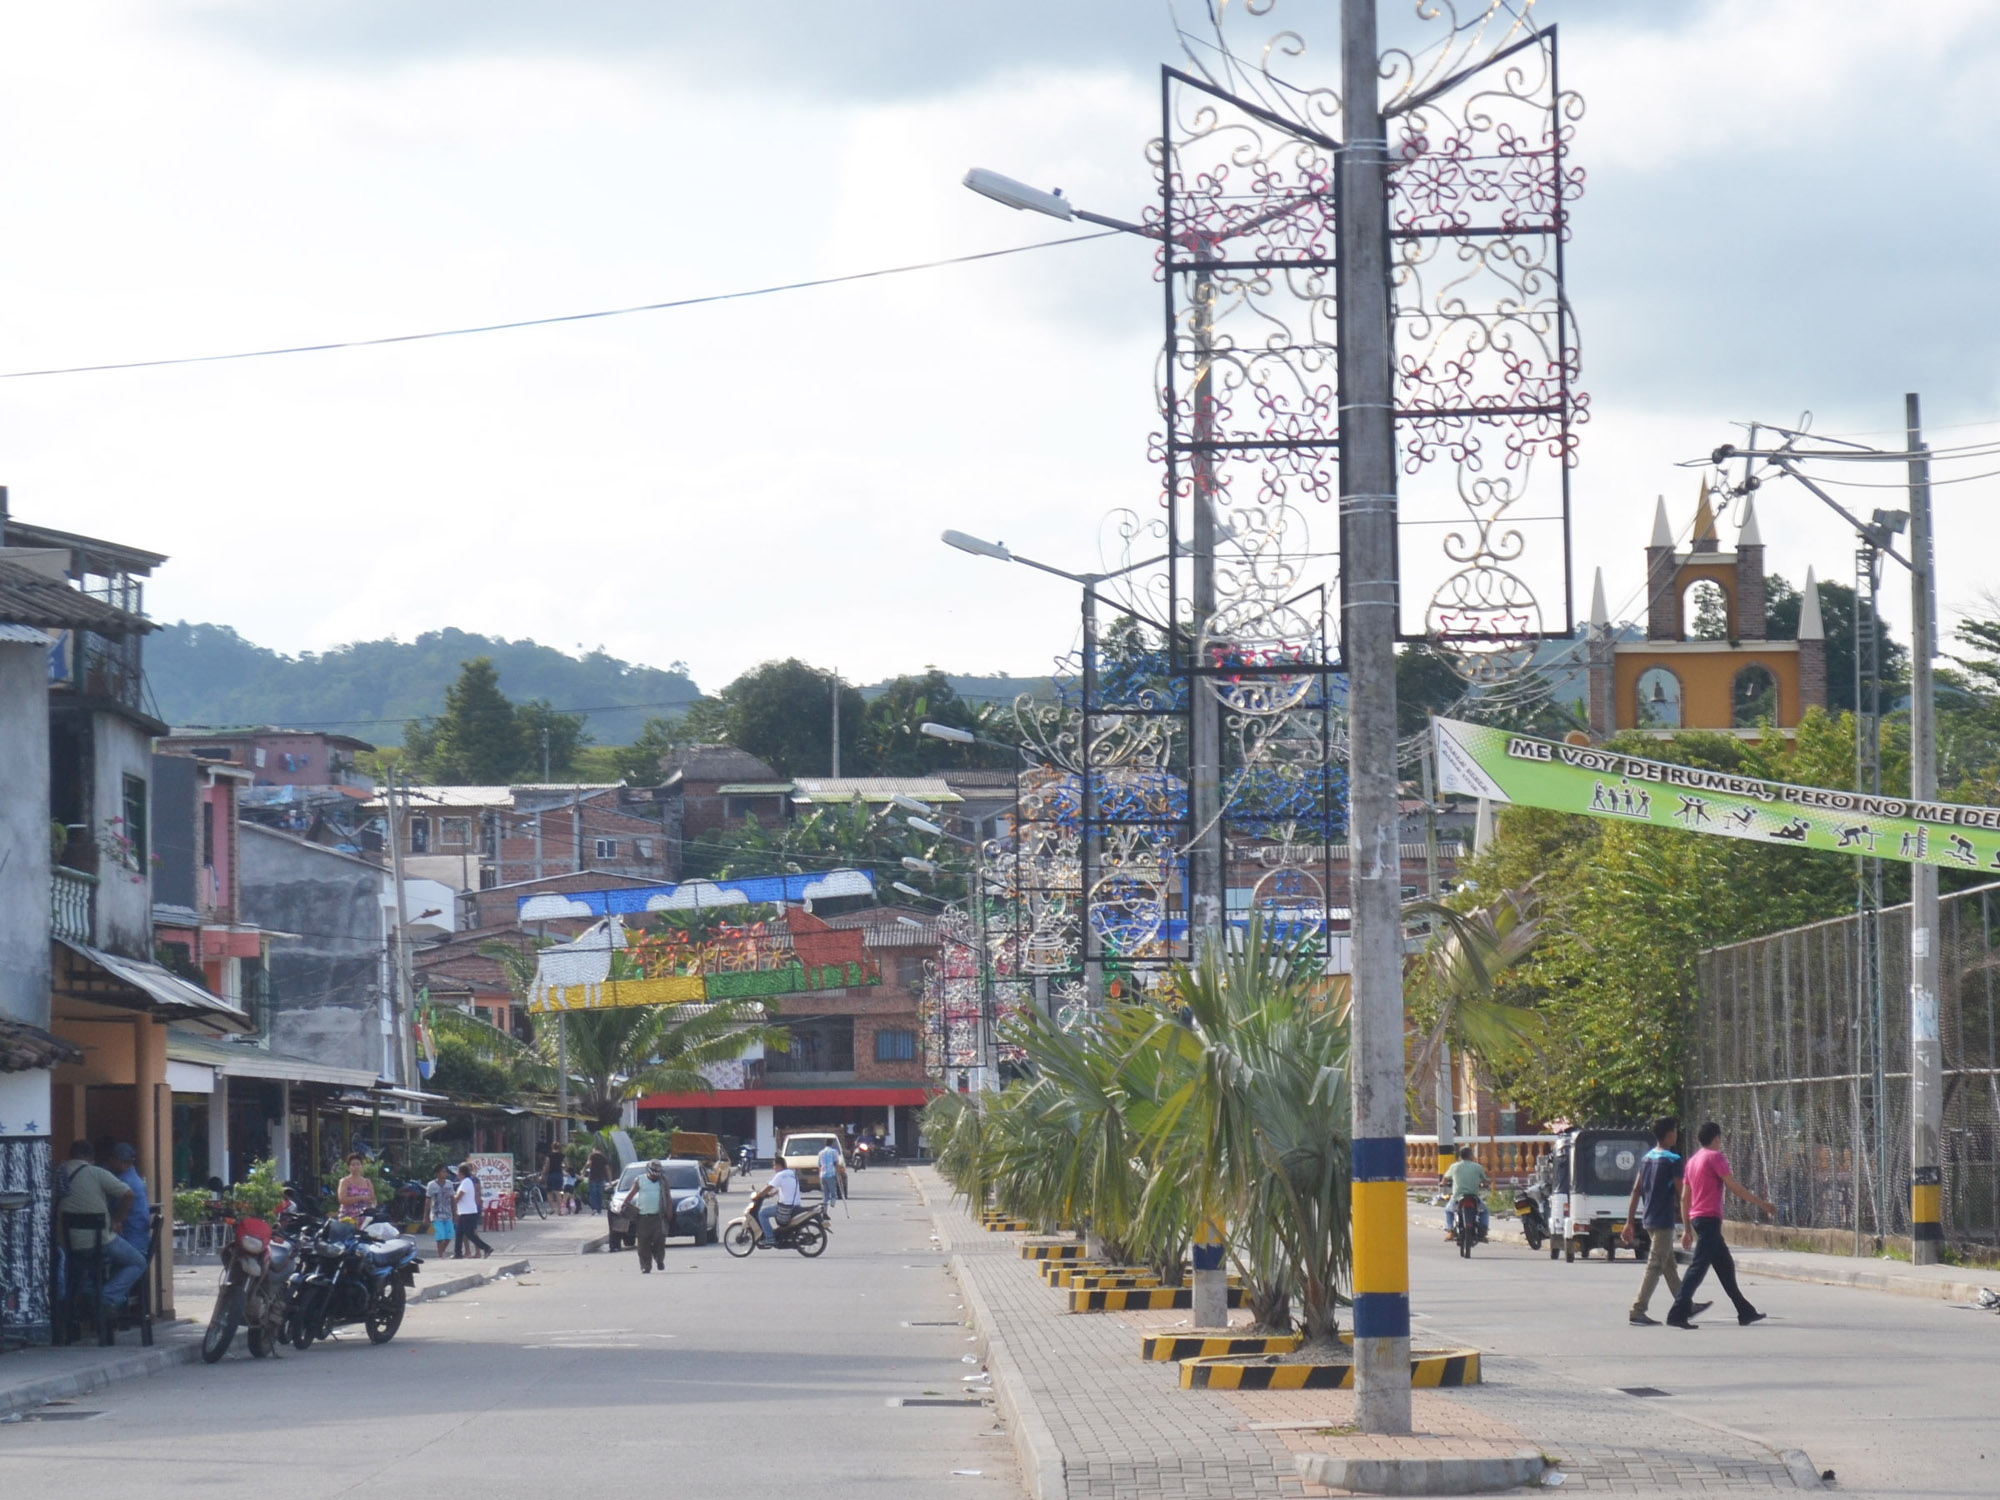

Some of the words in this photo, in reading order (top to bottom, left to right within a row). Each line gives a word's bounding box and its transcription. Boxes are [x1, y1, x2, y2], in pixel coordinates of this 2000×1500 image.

[1511, 740, 1550, 760] ME
[1561, 748, 1617, 772] VOY
[1626, 761, 1661, 780] DE
[1670, 769, 1774, 800] RUMBA,
[1784, 787, 1850, 809] PERO
[1862, 798, 1904, 815] NO
[1915, 804, 1955, 822] ME
[1963, 810, 2000, 828] DE
